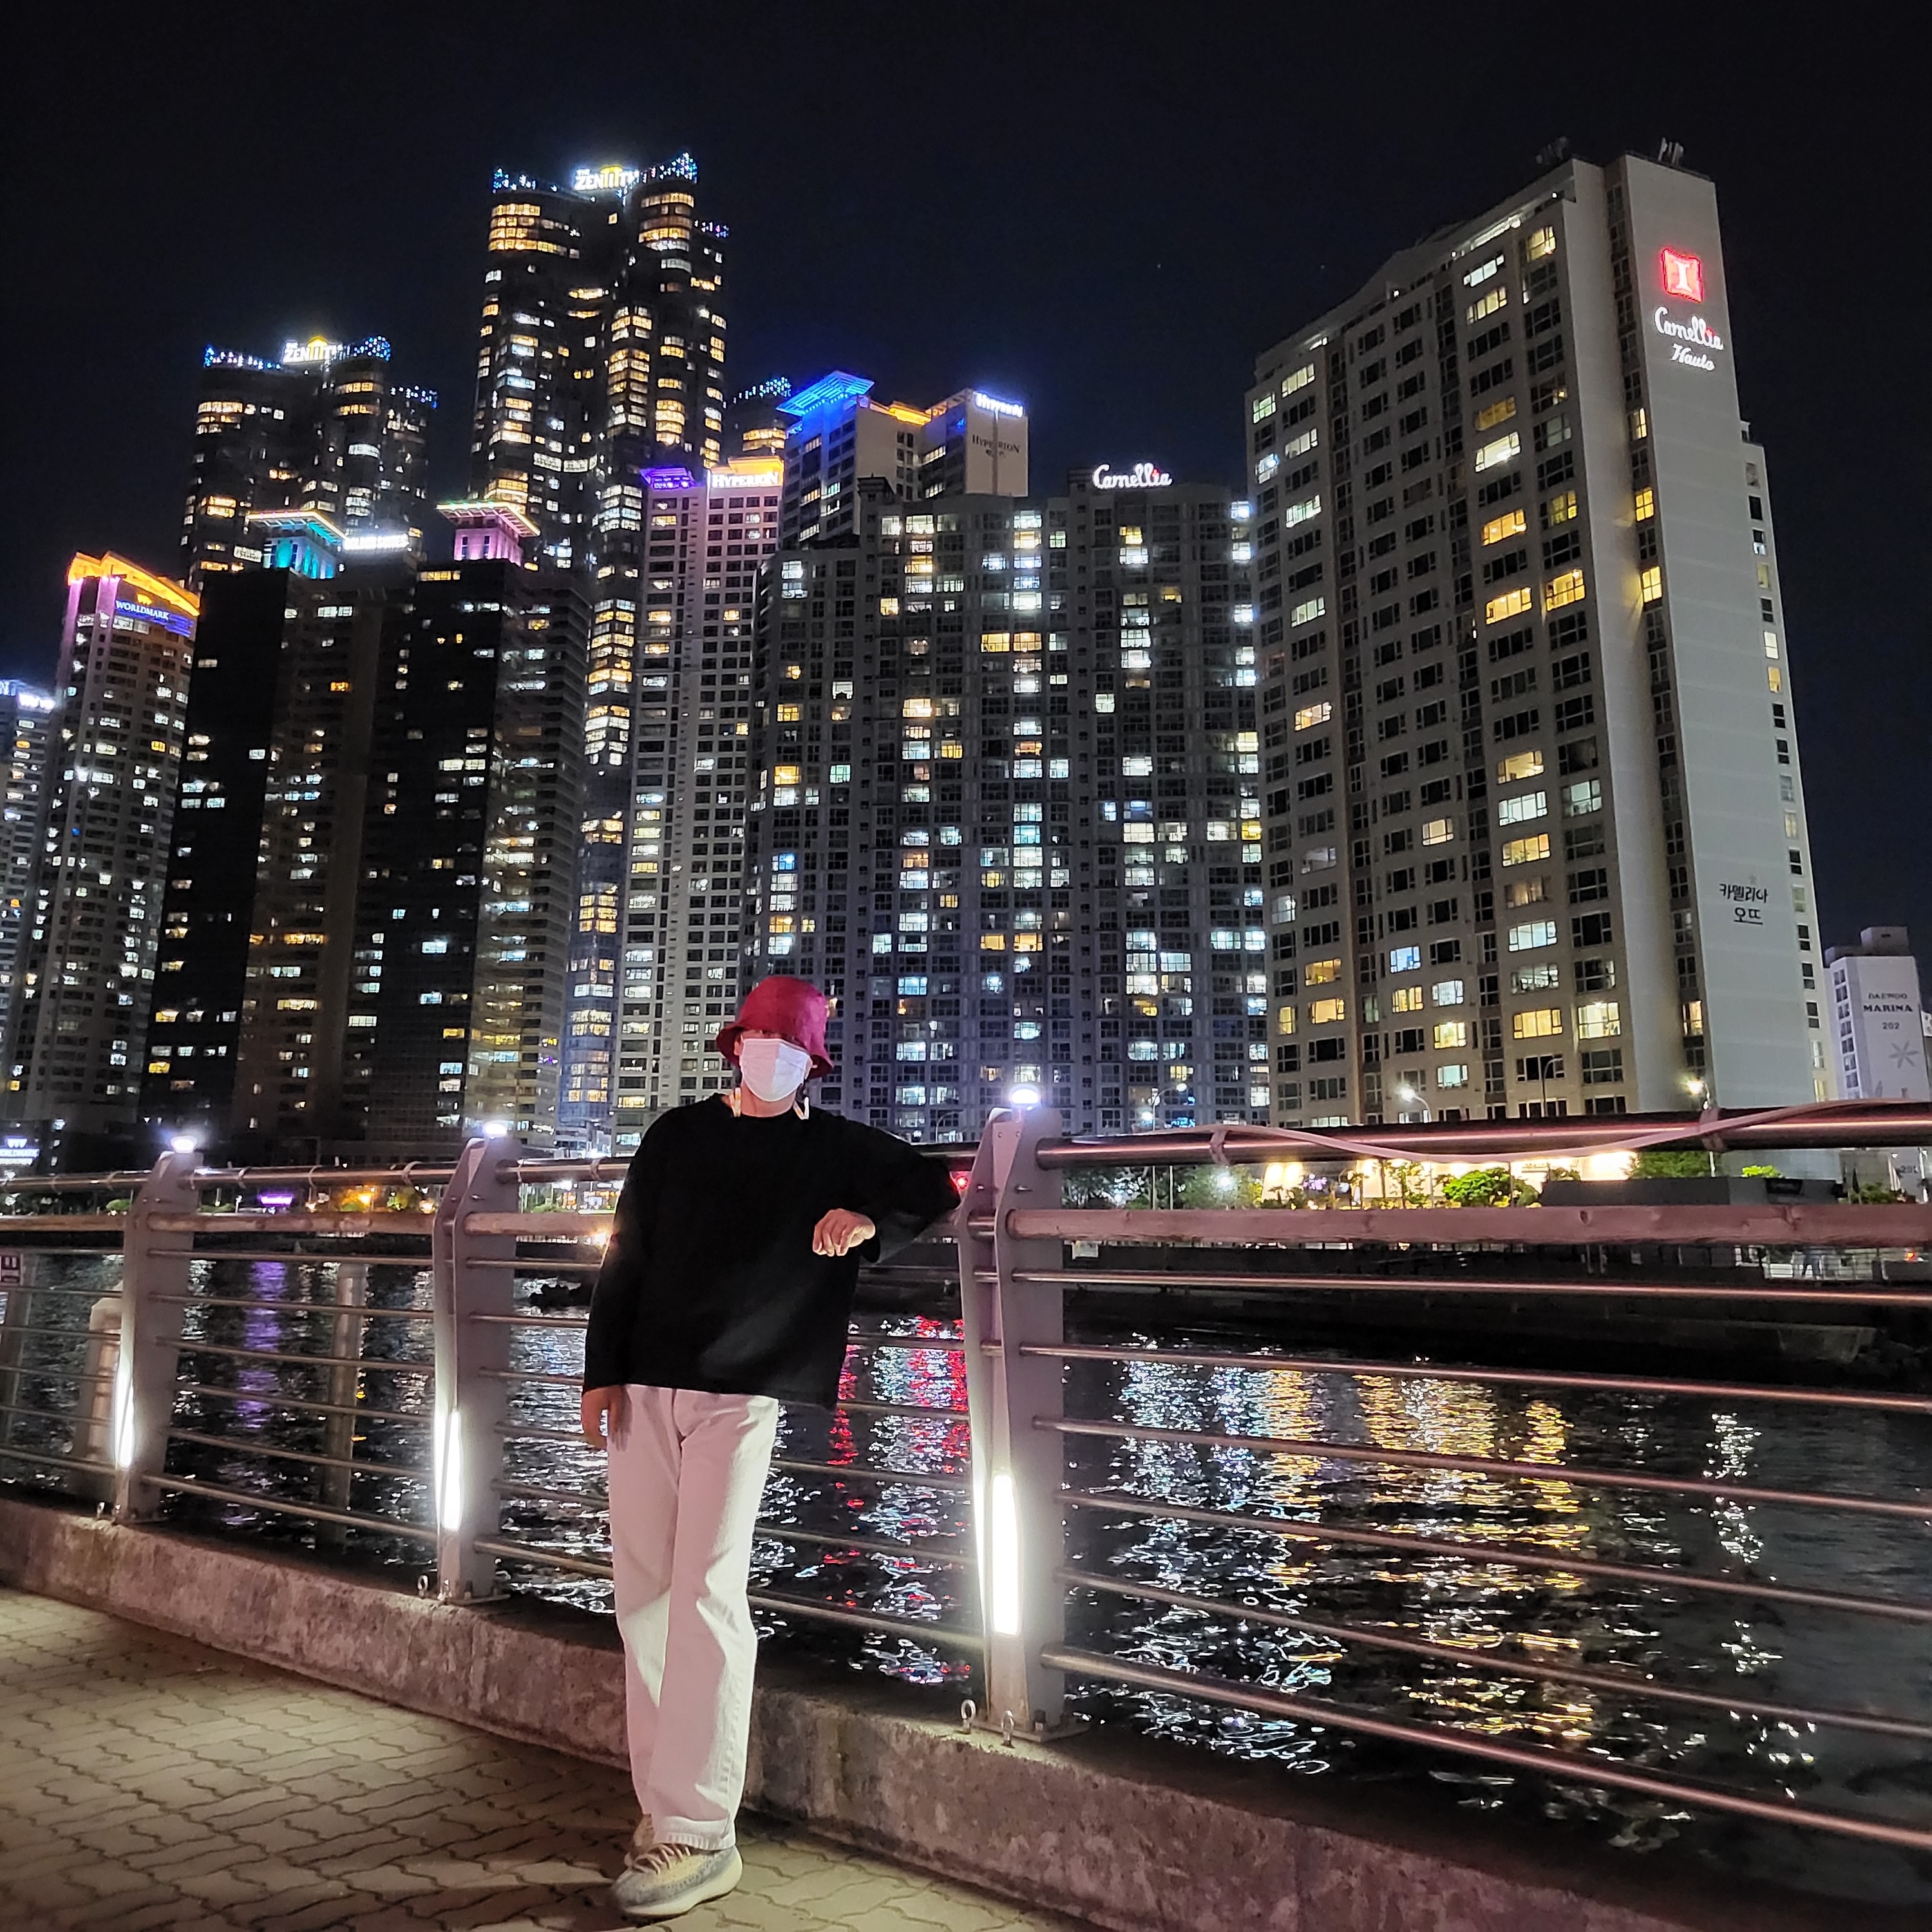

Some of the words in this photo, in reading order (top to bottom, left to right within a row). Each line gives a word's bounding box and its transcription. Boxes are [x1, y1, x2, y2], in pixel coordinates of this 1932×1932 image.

[1654, 306, 1724, 350] Camellia
[1671, 343, 1716, 371] Haute
[972, 434, 1020, 453] HYPRION
[712, 472, 779, 488] HYPERION
[1093, 462, 1173, 489] Camellia
[115, 600, 170, 620] WORLDMARK
[1719, 883, 1768, 904] 카멜리아
